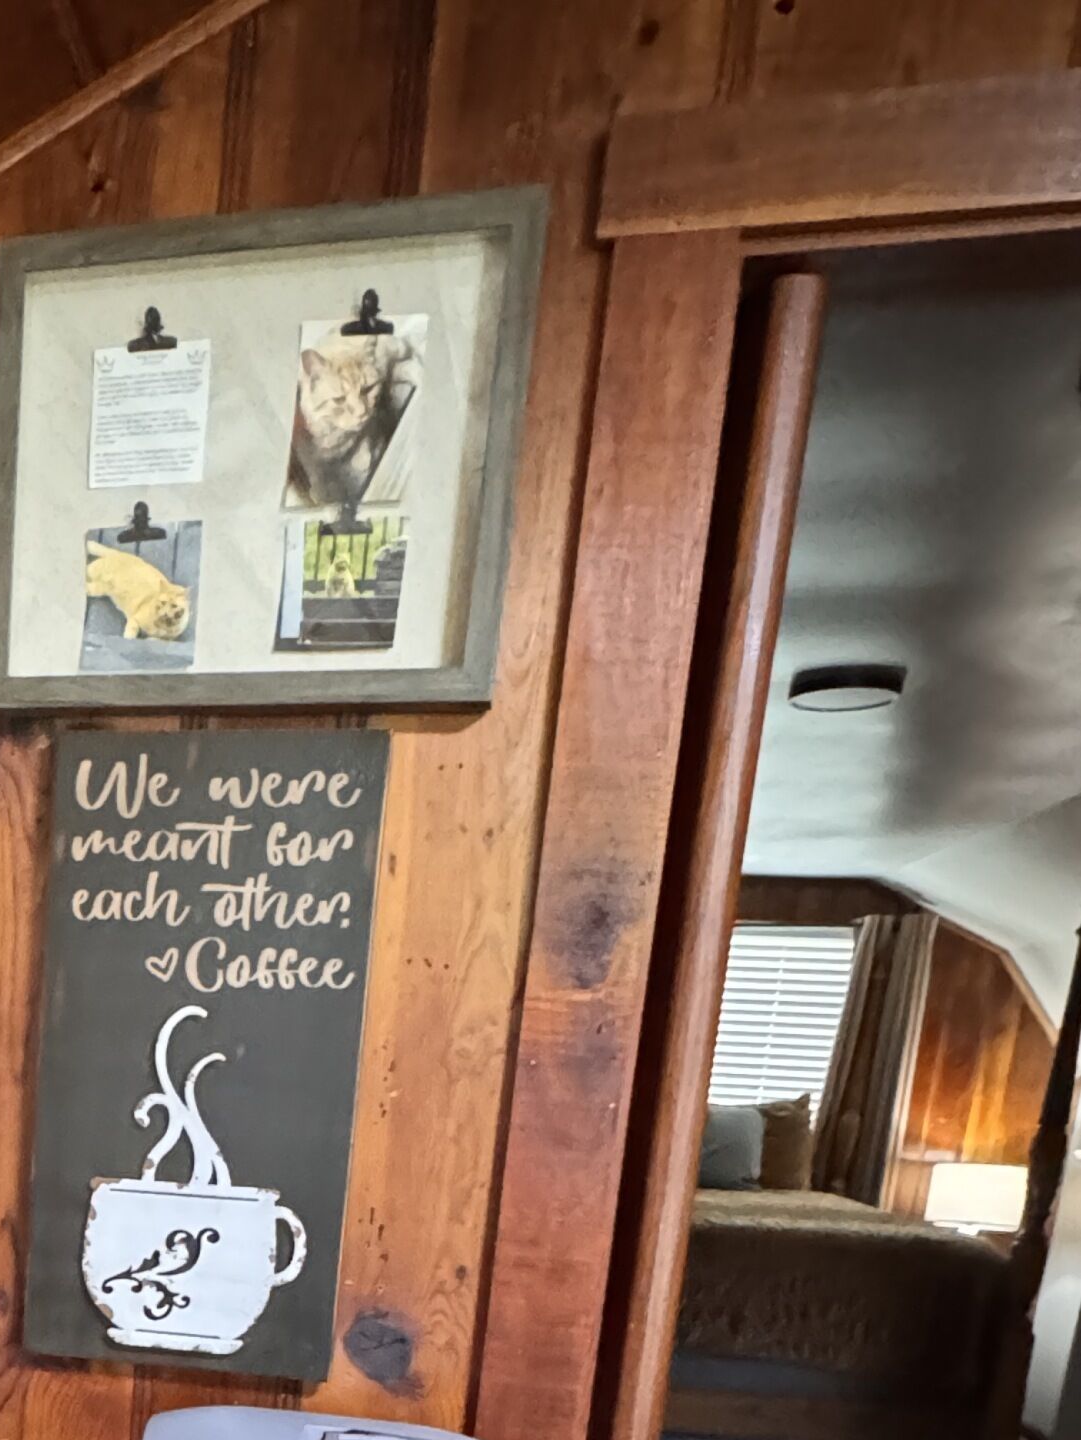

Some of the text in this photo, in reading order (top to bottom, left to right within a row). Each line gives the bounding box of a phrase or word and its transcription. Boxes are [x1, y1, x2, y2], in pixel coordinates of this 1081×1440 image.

[75, 753, 362, 819] We were
[71, 815, 353, 869] meant for
[71, 871, 351, 931] each other.
[184, 936, 356, 993] Coffee
